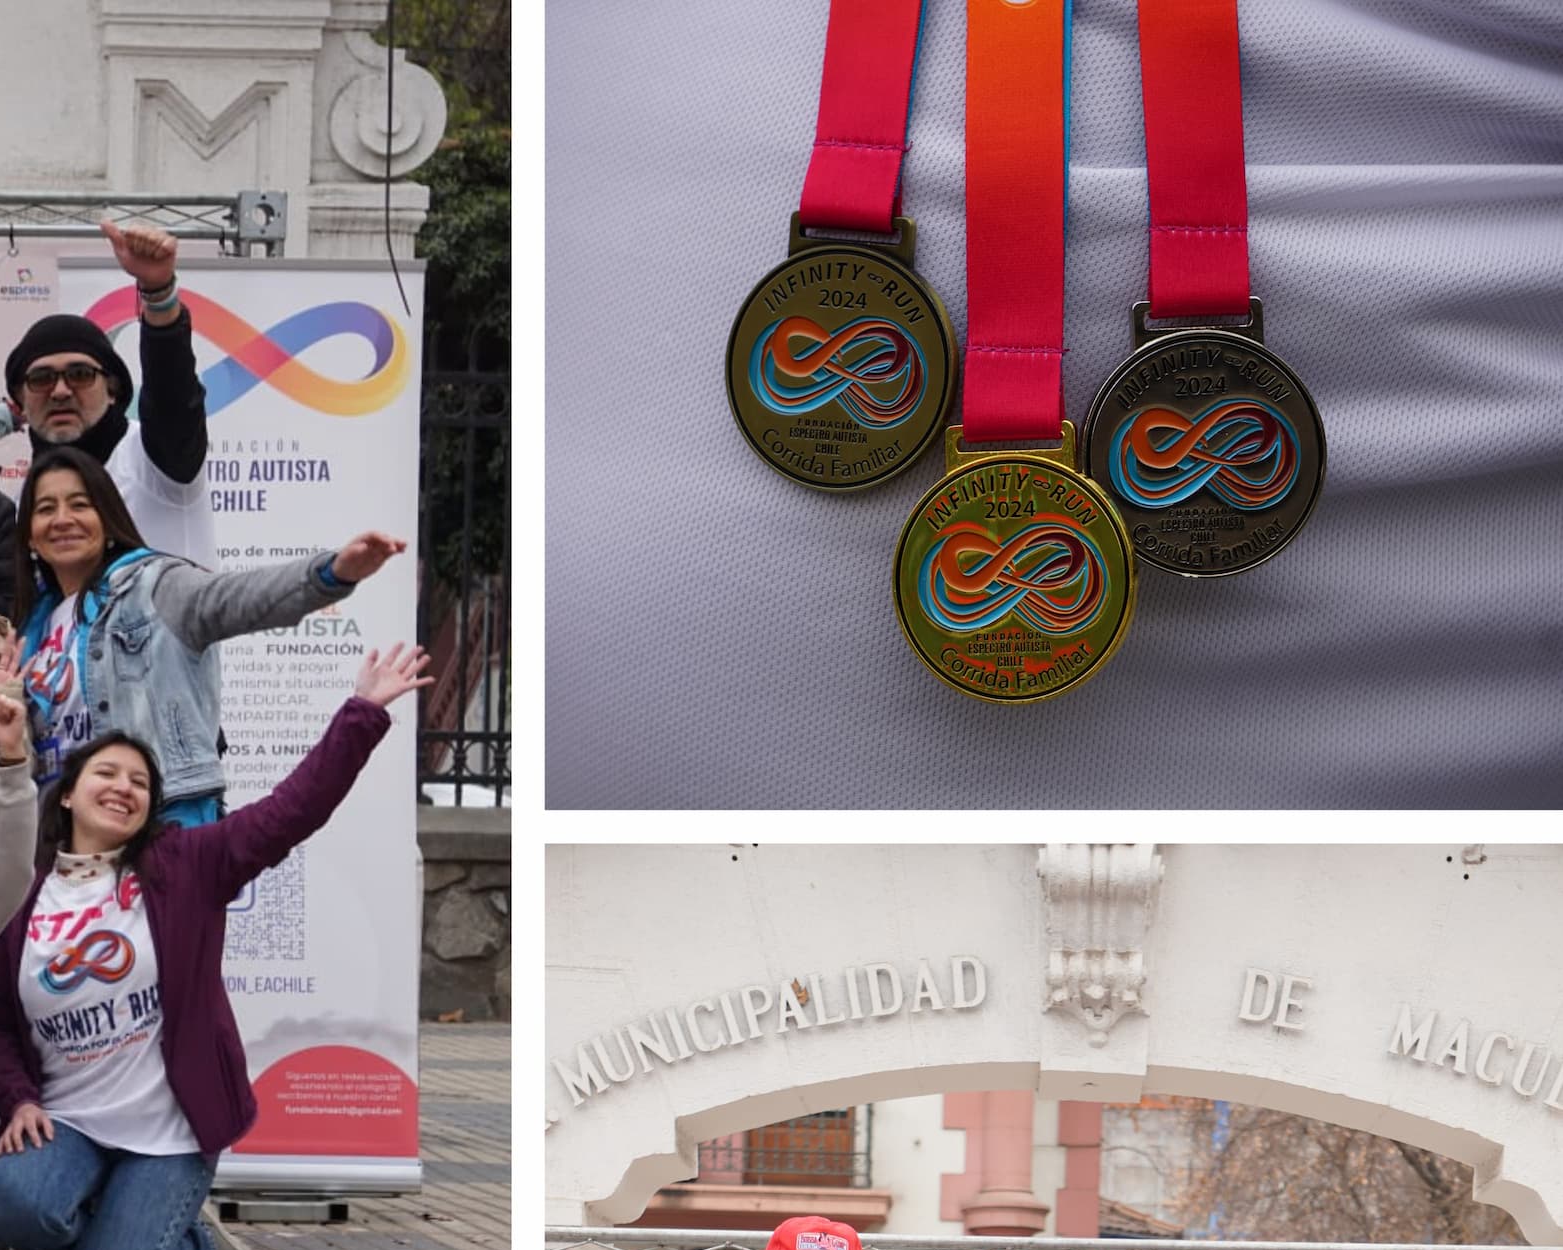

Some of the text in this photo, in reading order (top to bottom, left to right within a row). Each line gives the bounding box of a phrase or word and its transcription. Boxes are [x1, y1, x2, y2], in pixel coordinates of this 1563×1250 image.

[0, 284, 50, 297] espress
[764, 261, 926, 325] INFINITY RUN
[818, 288, 868, 309] 2024
[1112, 347, 1291, 410] INFINITY RUN
[1174, 376, 1227, 397] 2024
[797, 416, 861, 430] FUNDACIÓN
[789, 426, 868, 444] ESPECTRO AUTISTA
[761, 427, 903, 478] Corrida Familiar
[815, 442, 840, 455] CHILE
[249, 459, 330, 482] AUTISTA
[925, 472, 1099, 533] INFINITY RUN
[984, 500, 1037, 519] 2024
[245, 546, 264, 557] de
[1131, 518, 1286, 567] Corrida Familiar
[975, 629, 1043, 642] FUNDACIÓN
[267, 642, 363, 655] FUNDACIÓN
[967, 641, 1052, 655] ESPECTRO AUTISTA
[234, 660, 339, 676] vidas y apoyar
[939, 642, 1094, 689] Corrida Familiar
[996, 655, 1025, 668] CHILE
[230, 679, 280, 689] misma
[255, 745, 267, 755] A
[550, 954, 988, 1108] MUNICIPALIDAD
[1237, 965, 1314, 1032] DE
